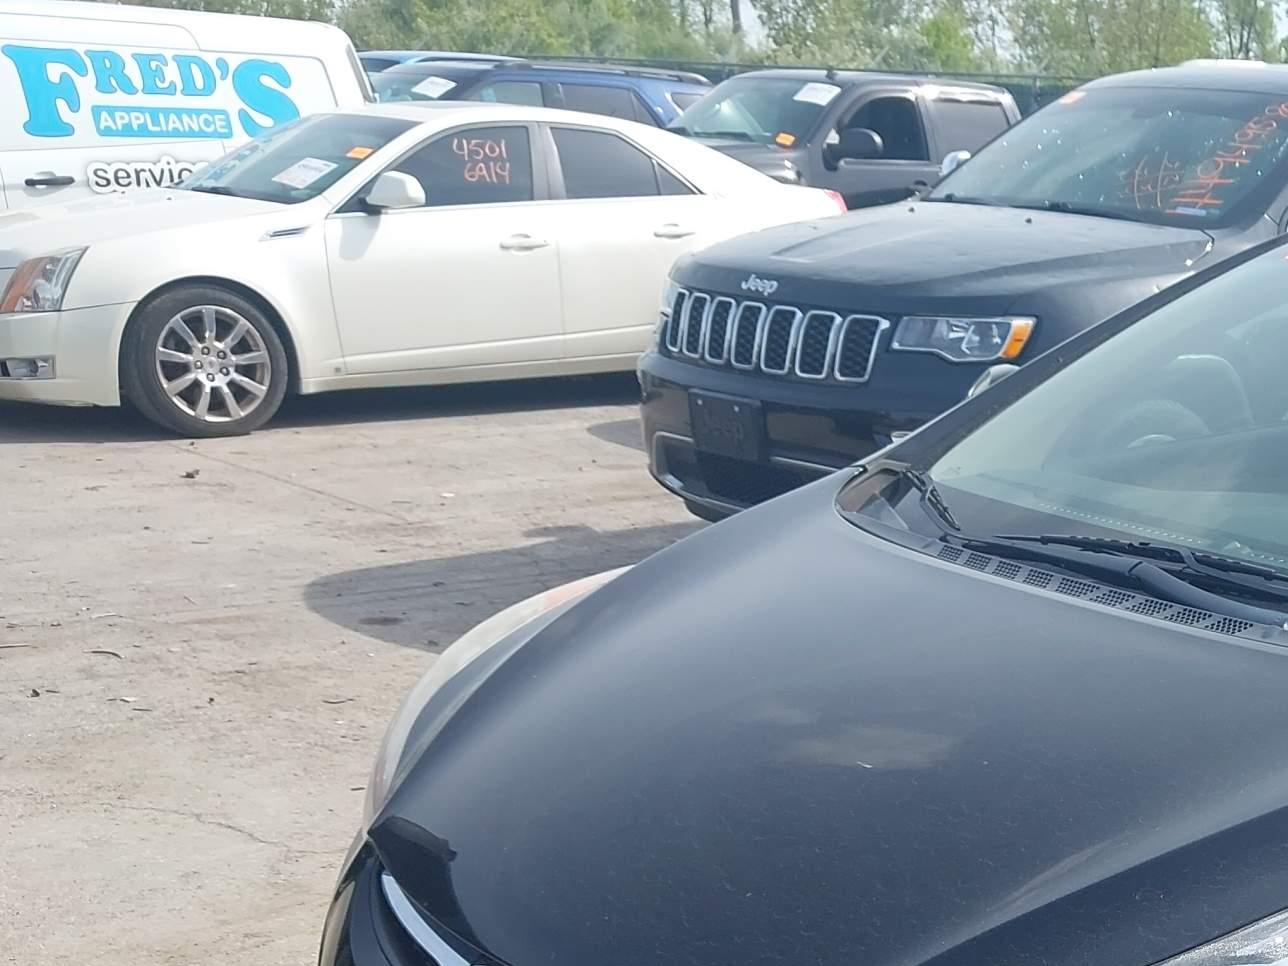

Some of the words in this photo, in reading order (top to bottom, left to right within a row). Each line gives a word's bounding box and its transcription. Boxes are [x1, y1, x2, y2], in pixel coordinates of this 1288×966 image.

[1, 45, 300, 138] FRED'S
[99, 112, 228, 133] APPLIANCE
[452, 138, 507, 160] 4501
[741, 274, 778, 295] Jeep
